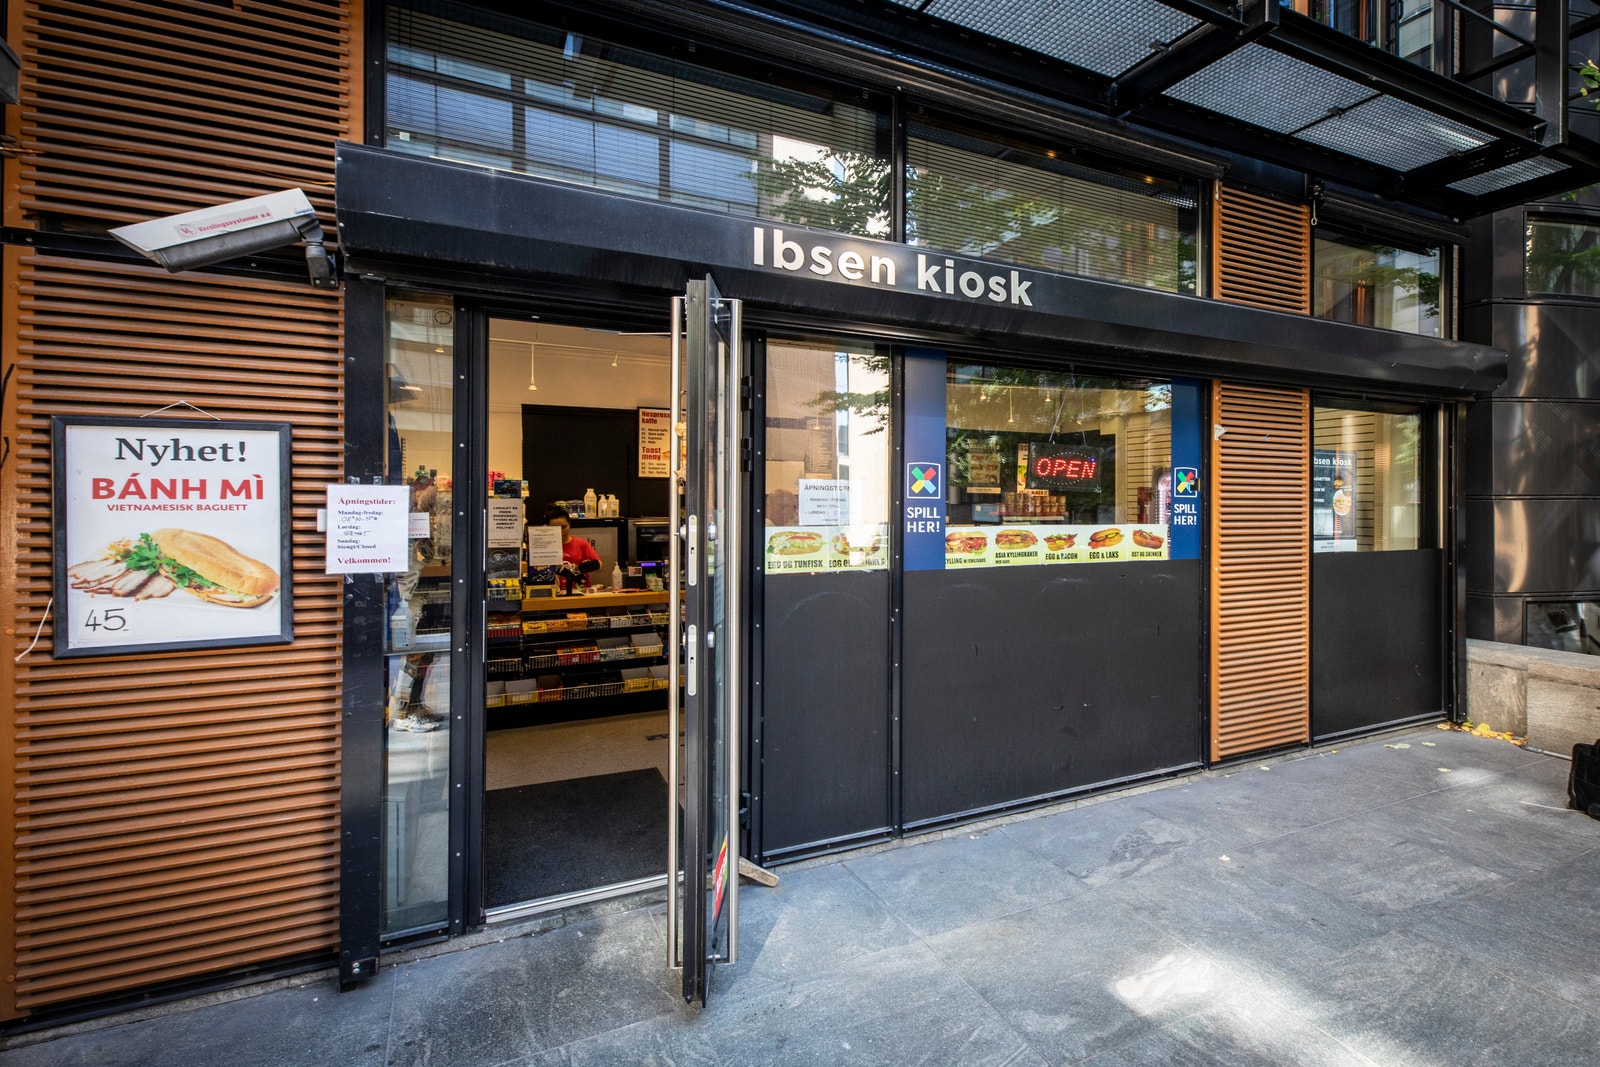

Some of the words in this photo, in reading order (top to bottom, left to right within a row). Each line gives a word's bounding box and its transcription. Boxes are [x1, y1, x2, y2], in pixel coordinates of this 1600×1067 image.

[753, 227, 896, 286] Ibsen
[918, 254, 1033, 306] kiosk
[115, 438, 246, 466] Nyhet!
[1332, 458, 1352, 466] kiosk
[1036, 458, 1096, 479] OPEN
[92, 472, 207, 500] BÁNH
[220, 474, 263, 500] MÌ
[338, 497, 396, 506] Åpningstider:
[906, 507, 940, 519] SPILL
[1174, 504, 1197, 514] SPILL
[1174, 516, 1197, 525] HER!
[906, 521, 940, 533] HER!
[768, 561, 780, 569] EGG
[794, 560, 823, 568] TUNFISK
[829, 560, 842, 568] EGG
